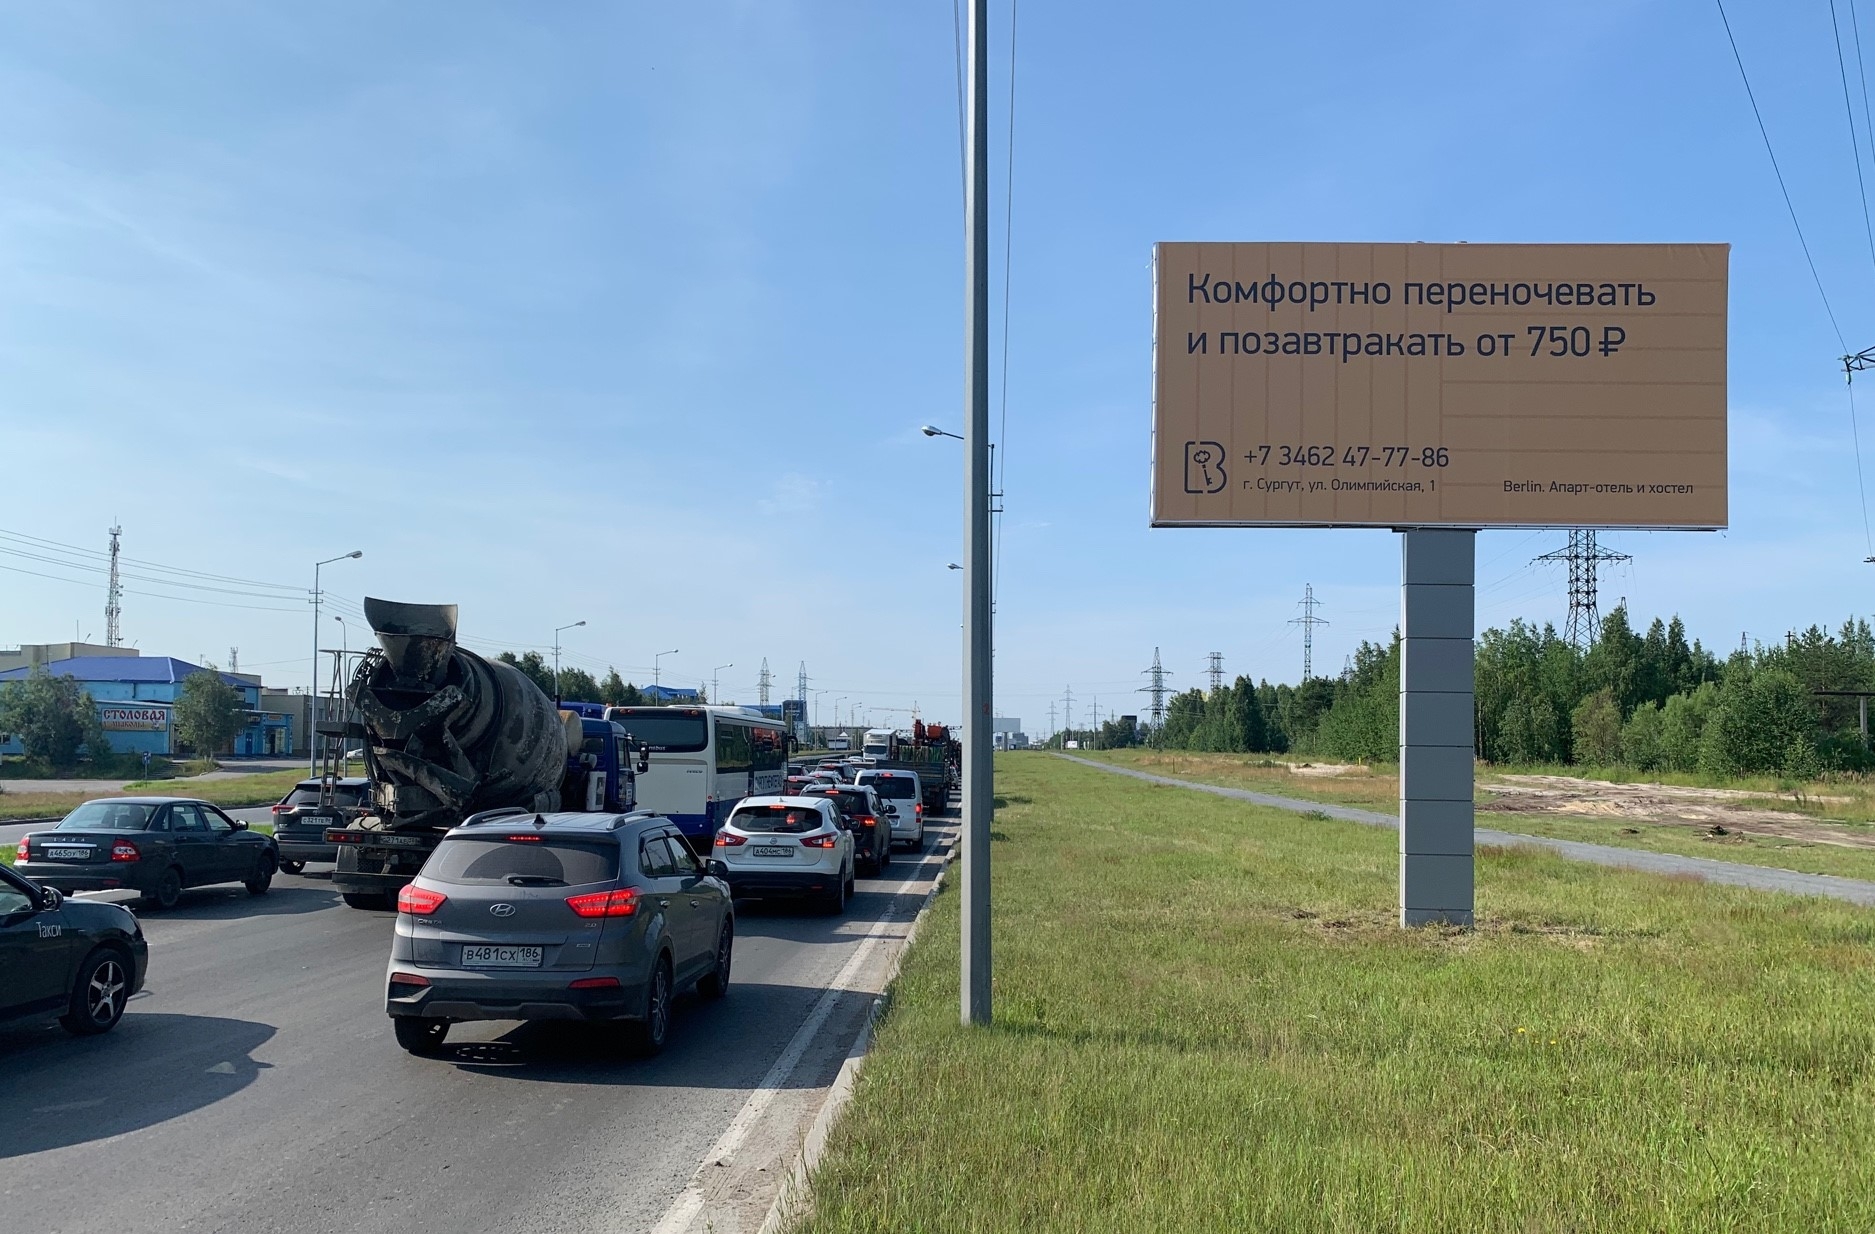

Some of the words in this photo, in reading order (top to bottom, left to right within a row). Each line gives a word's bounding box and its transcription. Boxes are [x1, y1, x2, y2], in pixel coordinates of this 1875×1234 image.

[1188, 273, 1391, 313] Комфортно
[1404, 282, 1656, 314] переночевать
[1187, 332, 1207, 355] и
[1220, 332, 1465, 364] позавтракать
[1476, 333, 1516, 357] от
[1243, 445, 1272, 466] +7
[1278, 445, 1335, 467] 3462
[1342, 446, 1449, 468] 47-77-86
[1243, 480, 1253, 490] г.
[1256, 477, 1305, 493] Сургут,
[1308, 481, 1327, 494] ул.
[1331, 477, 1425, 494] Олимпийская,
[1430, 479, 1436, 492] 1
[1503, 479, 1545, 493] Berlin.
[1548, 480, 1633, 496] Апарт-отель
[1636, 483, 1645, 494] и
[1648, 483, 1694, 494] хостел
[103, 709, 165, 721] СТОЛОВАЯ
[36, 921, 62, 938] Такси
